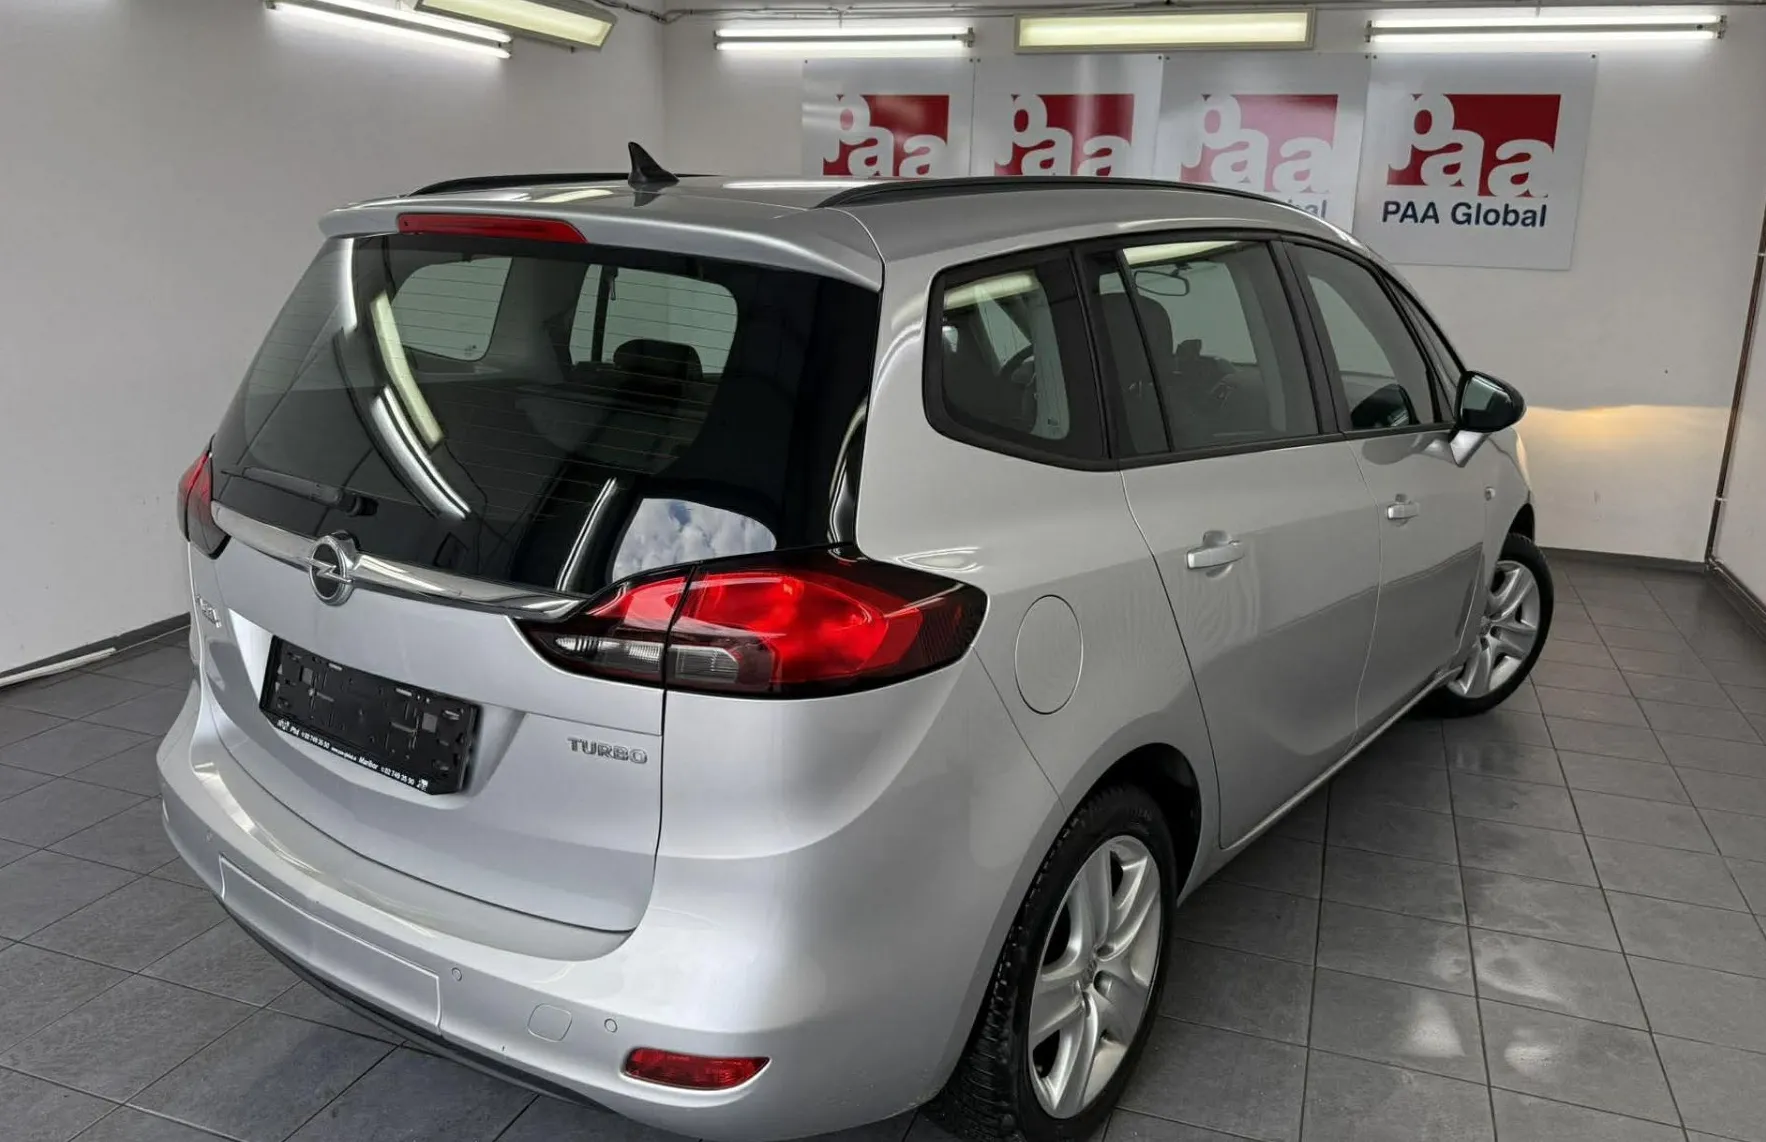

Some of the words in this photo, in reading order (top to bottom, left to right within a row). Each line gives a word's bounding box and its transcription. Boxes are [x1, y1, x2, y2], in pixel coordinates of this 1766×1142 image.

[823, 94, 949, 176] paa
[995, 94, 1135, 176] paa
[1180, 94, 1338, 193] paa
[1387, 93, 1561, 197] paa
[1381, 200, 1440, 225] PAA
[1450, 201, 1548, 228] Global
[567, 736, 648, 764] TURBO
